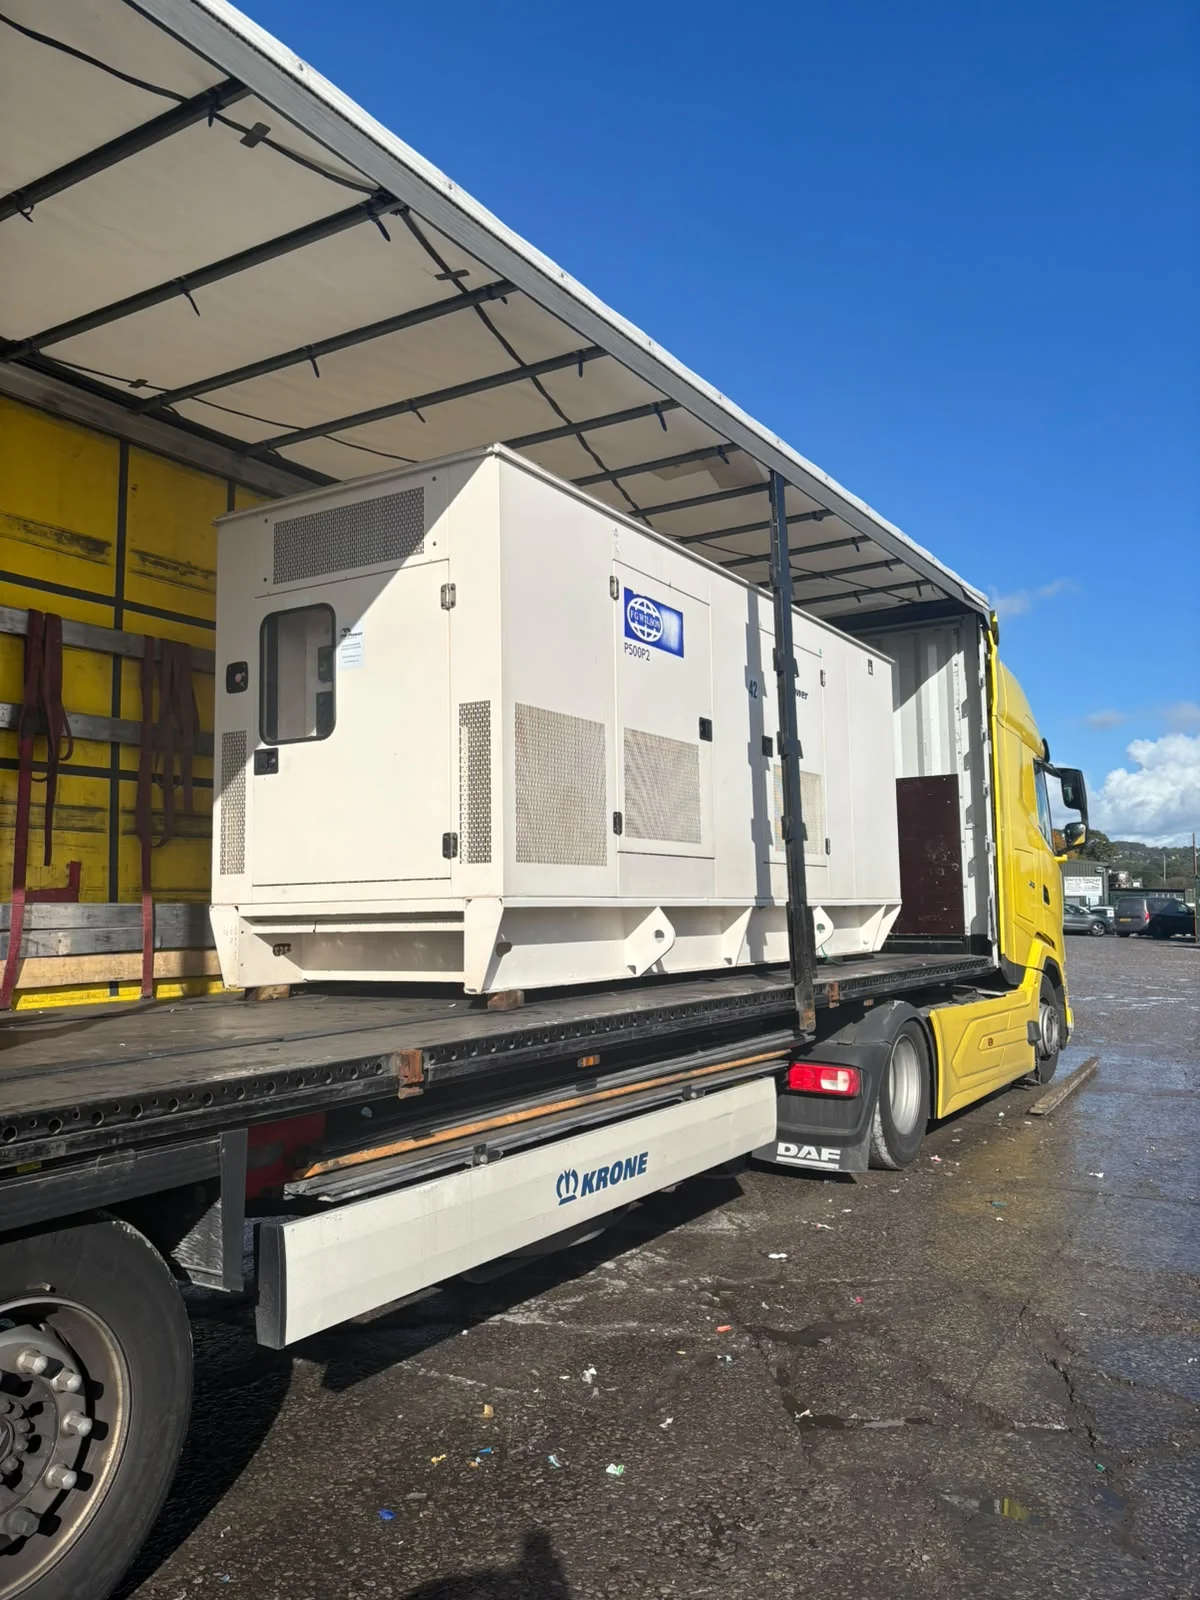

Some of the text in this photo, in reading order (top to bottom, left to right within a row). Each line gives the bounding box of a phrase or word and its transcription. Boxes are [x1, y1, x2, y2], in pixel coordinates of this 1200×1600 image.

[630, 609, 661, 629] FG WILSON
[624, 642, 651, 661] P500P2
[749, 679, 758, 700] 42
[777, 1142, 841, 1161] DAF
[580, 1151, 649, 1198] KRONE
